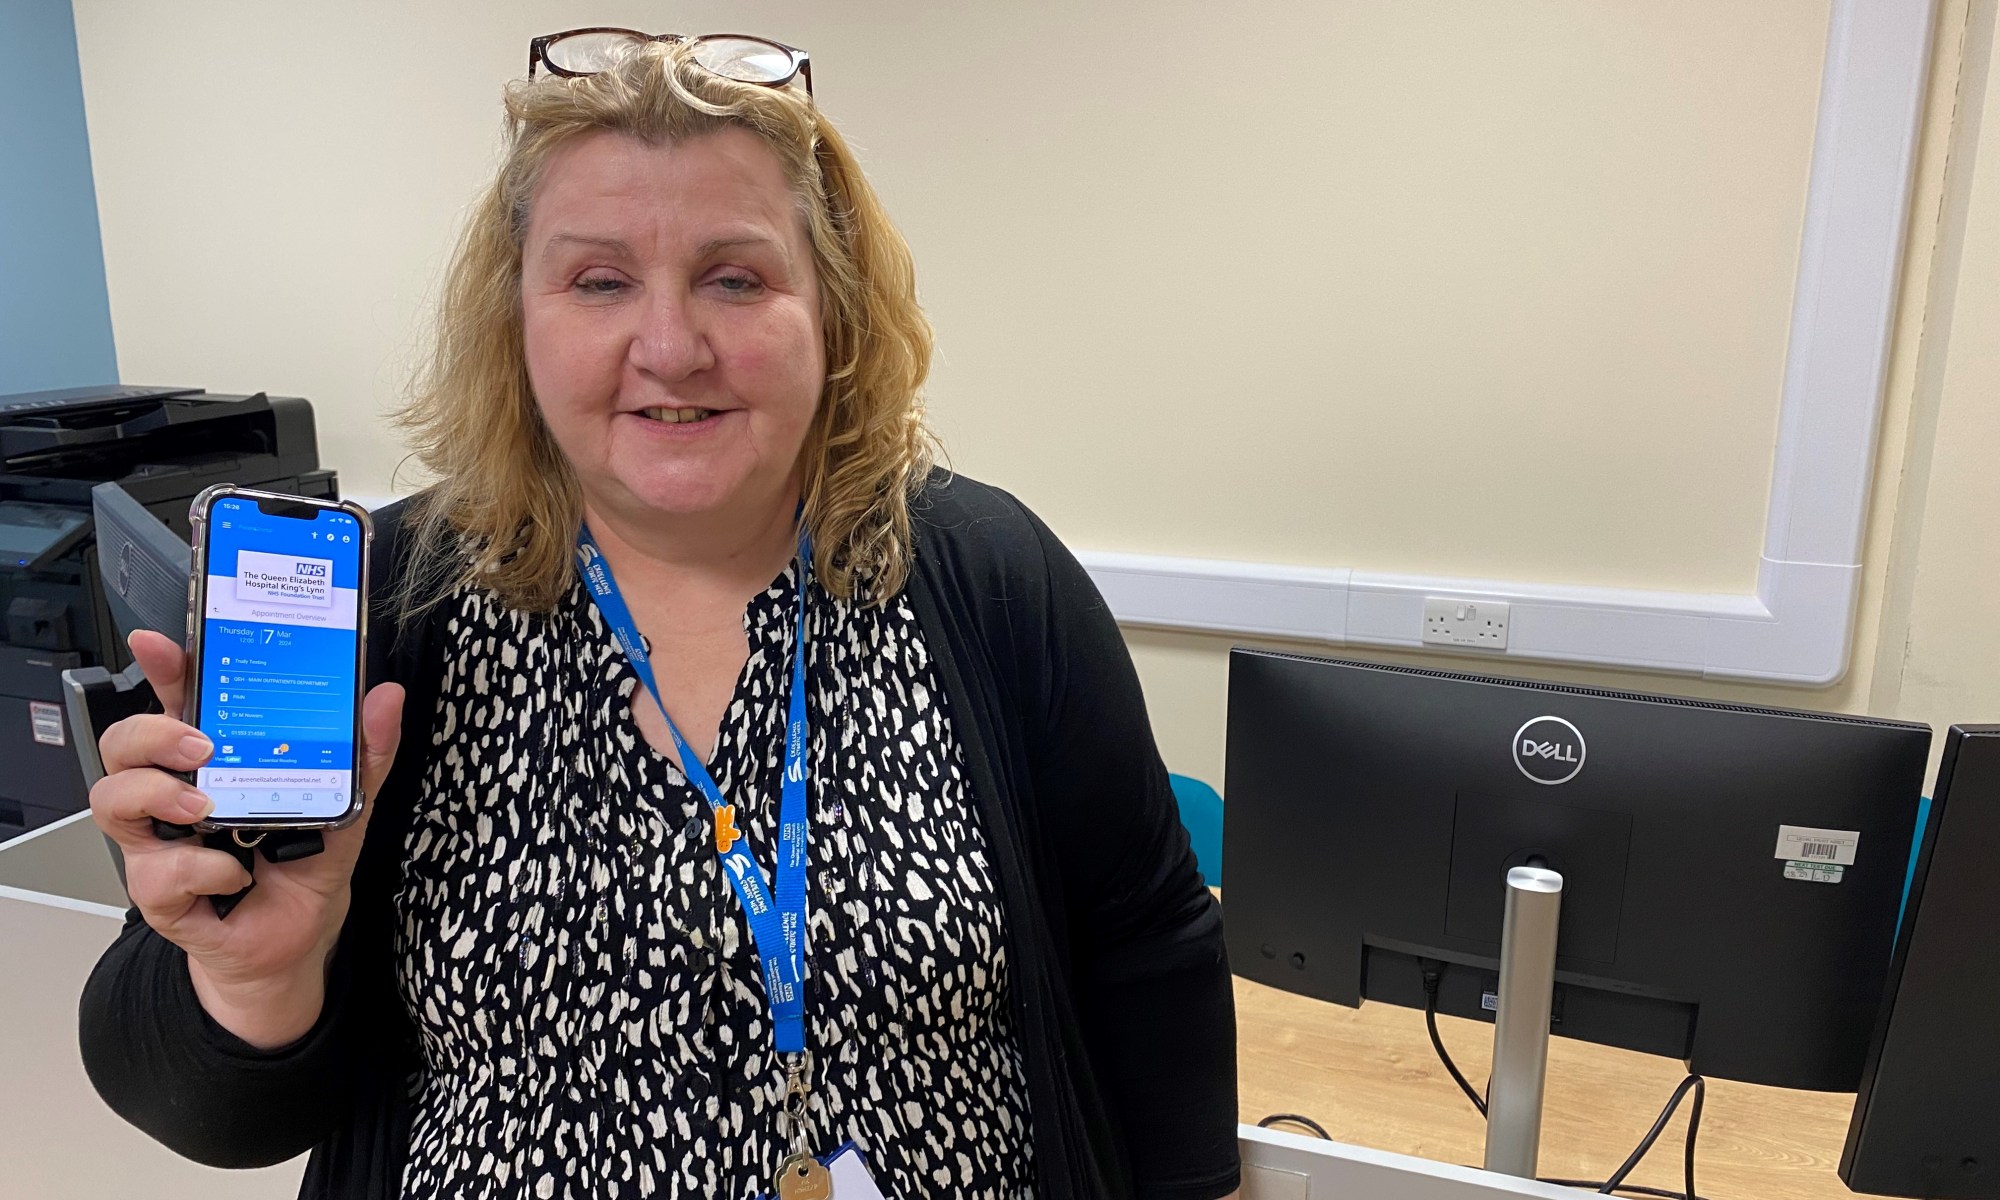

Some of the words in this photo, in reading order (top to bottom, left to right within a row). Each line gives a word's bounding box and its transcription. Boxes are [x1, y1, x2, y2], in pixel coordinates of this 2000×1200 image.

[297, 563, 325, 576] NHS
[244, 572, 259, 580] The
[261, 573, 288, 582] Queen
[290, 576, 325, 586] Elizabeth
[246, 580, 279, 590] Hospital
[280, 584, 304, 593] King's
[306, 586, 325, 594] Lynn
[280, 591, 310, 600] Foundation
[251, 610, 295, 620] Appointment
[297, 614, 326, 622] Overview
[219, 626, 254, 637] Thursday
[263, 629, 274, 645] 7
[1522, 738, 1578, 762] DELL
[746, 876, 768, 914] EXCELLENCE
[784, 982, 794, 1002] NHS
